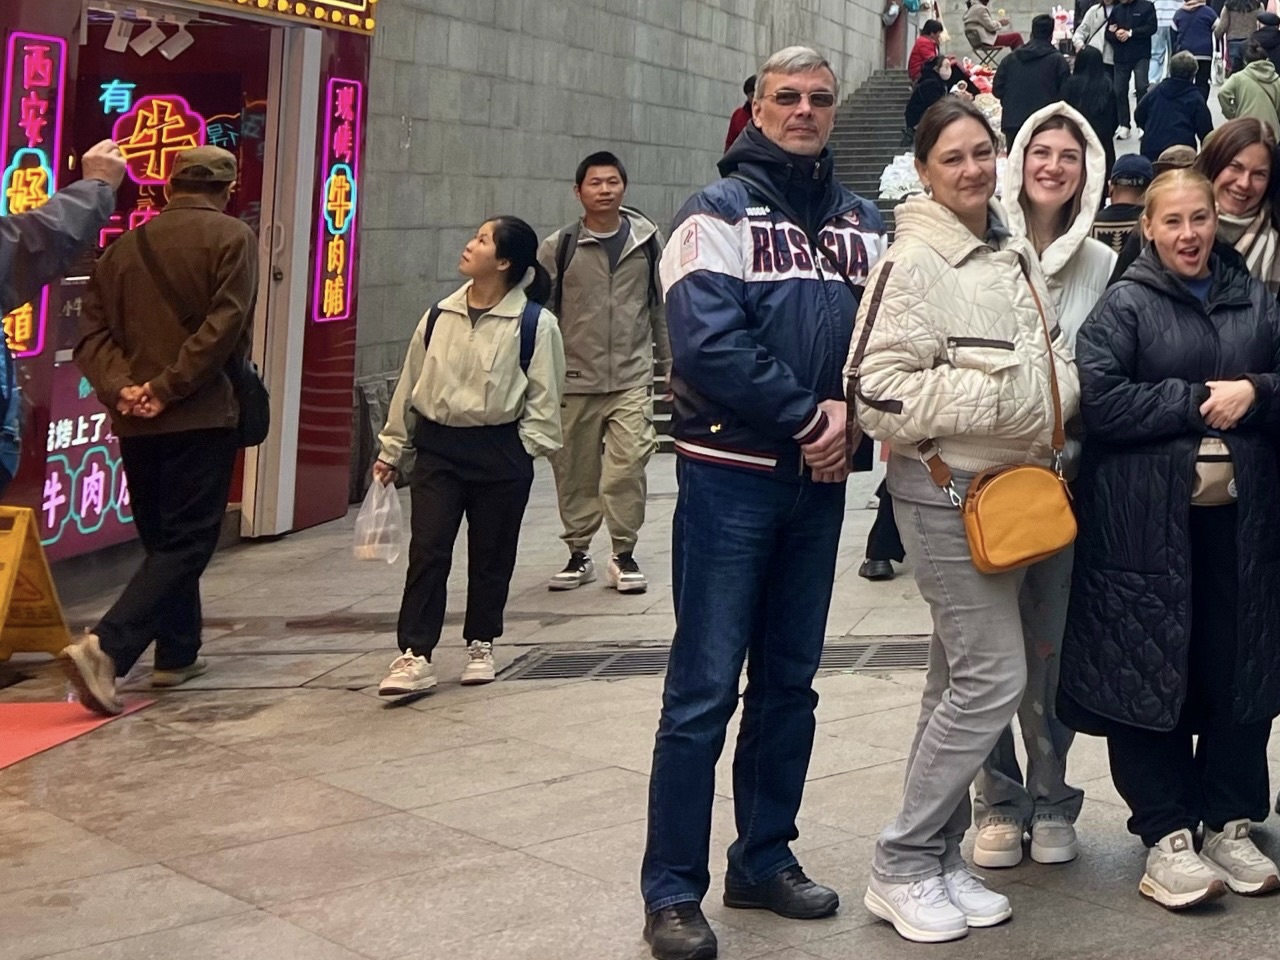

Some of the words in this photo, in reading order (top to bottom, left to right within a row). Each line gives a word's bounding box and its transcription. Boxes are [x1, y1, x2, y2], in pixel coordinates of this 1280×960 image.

[99, 79, 137, 114] 有
[118, 99, 197, 179] 牛
[750, 225, 870, 278] RUSSIA
